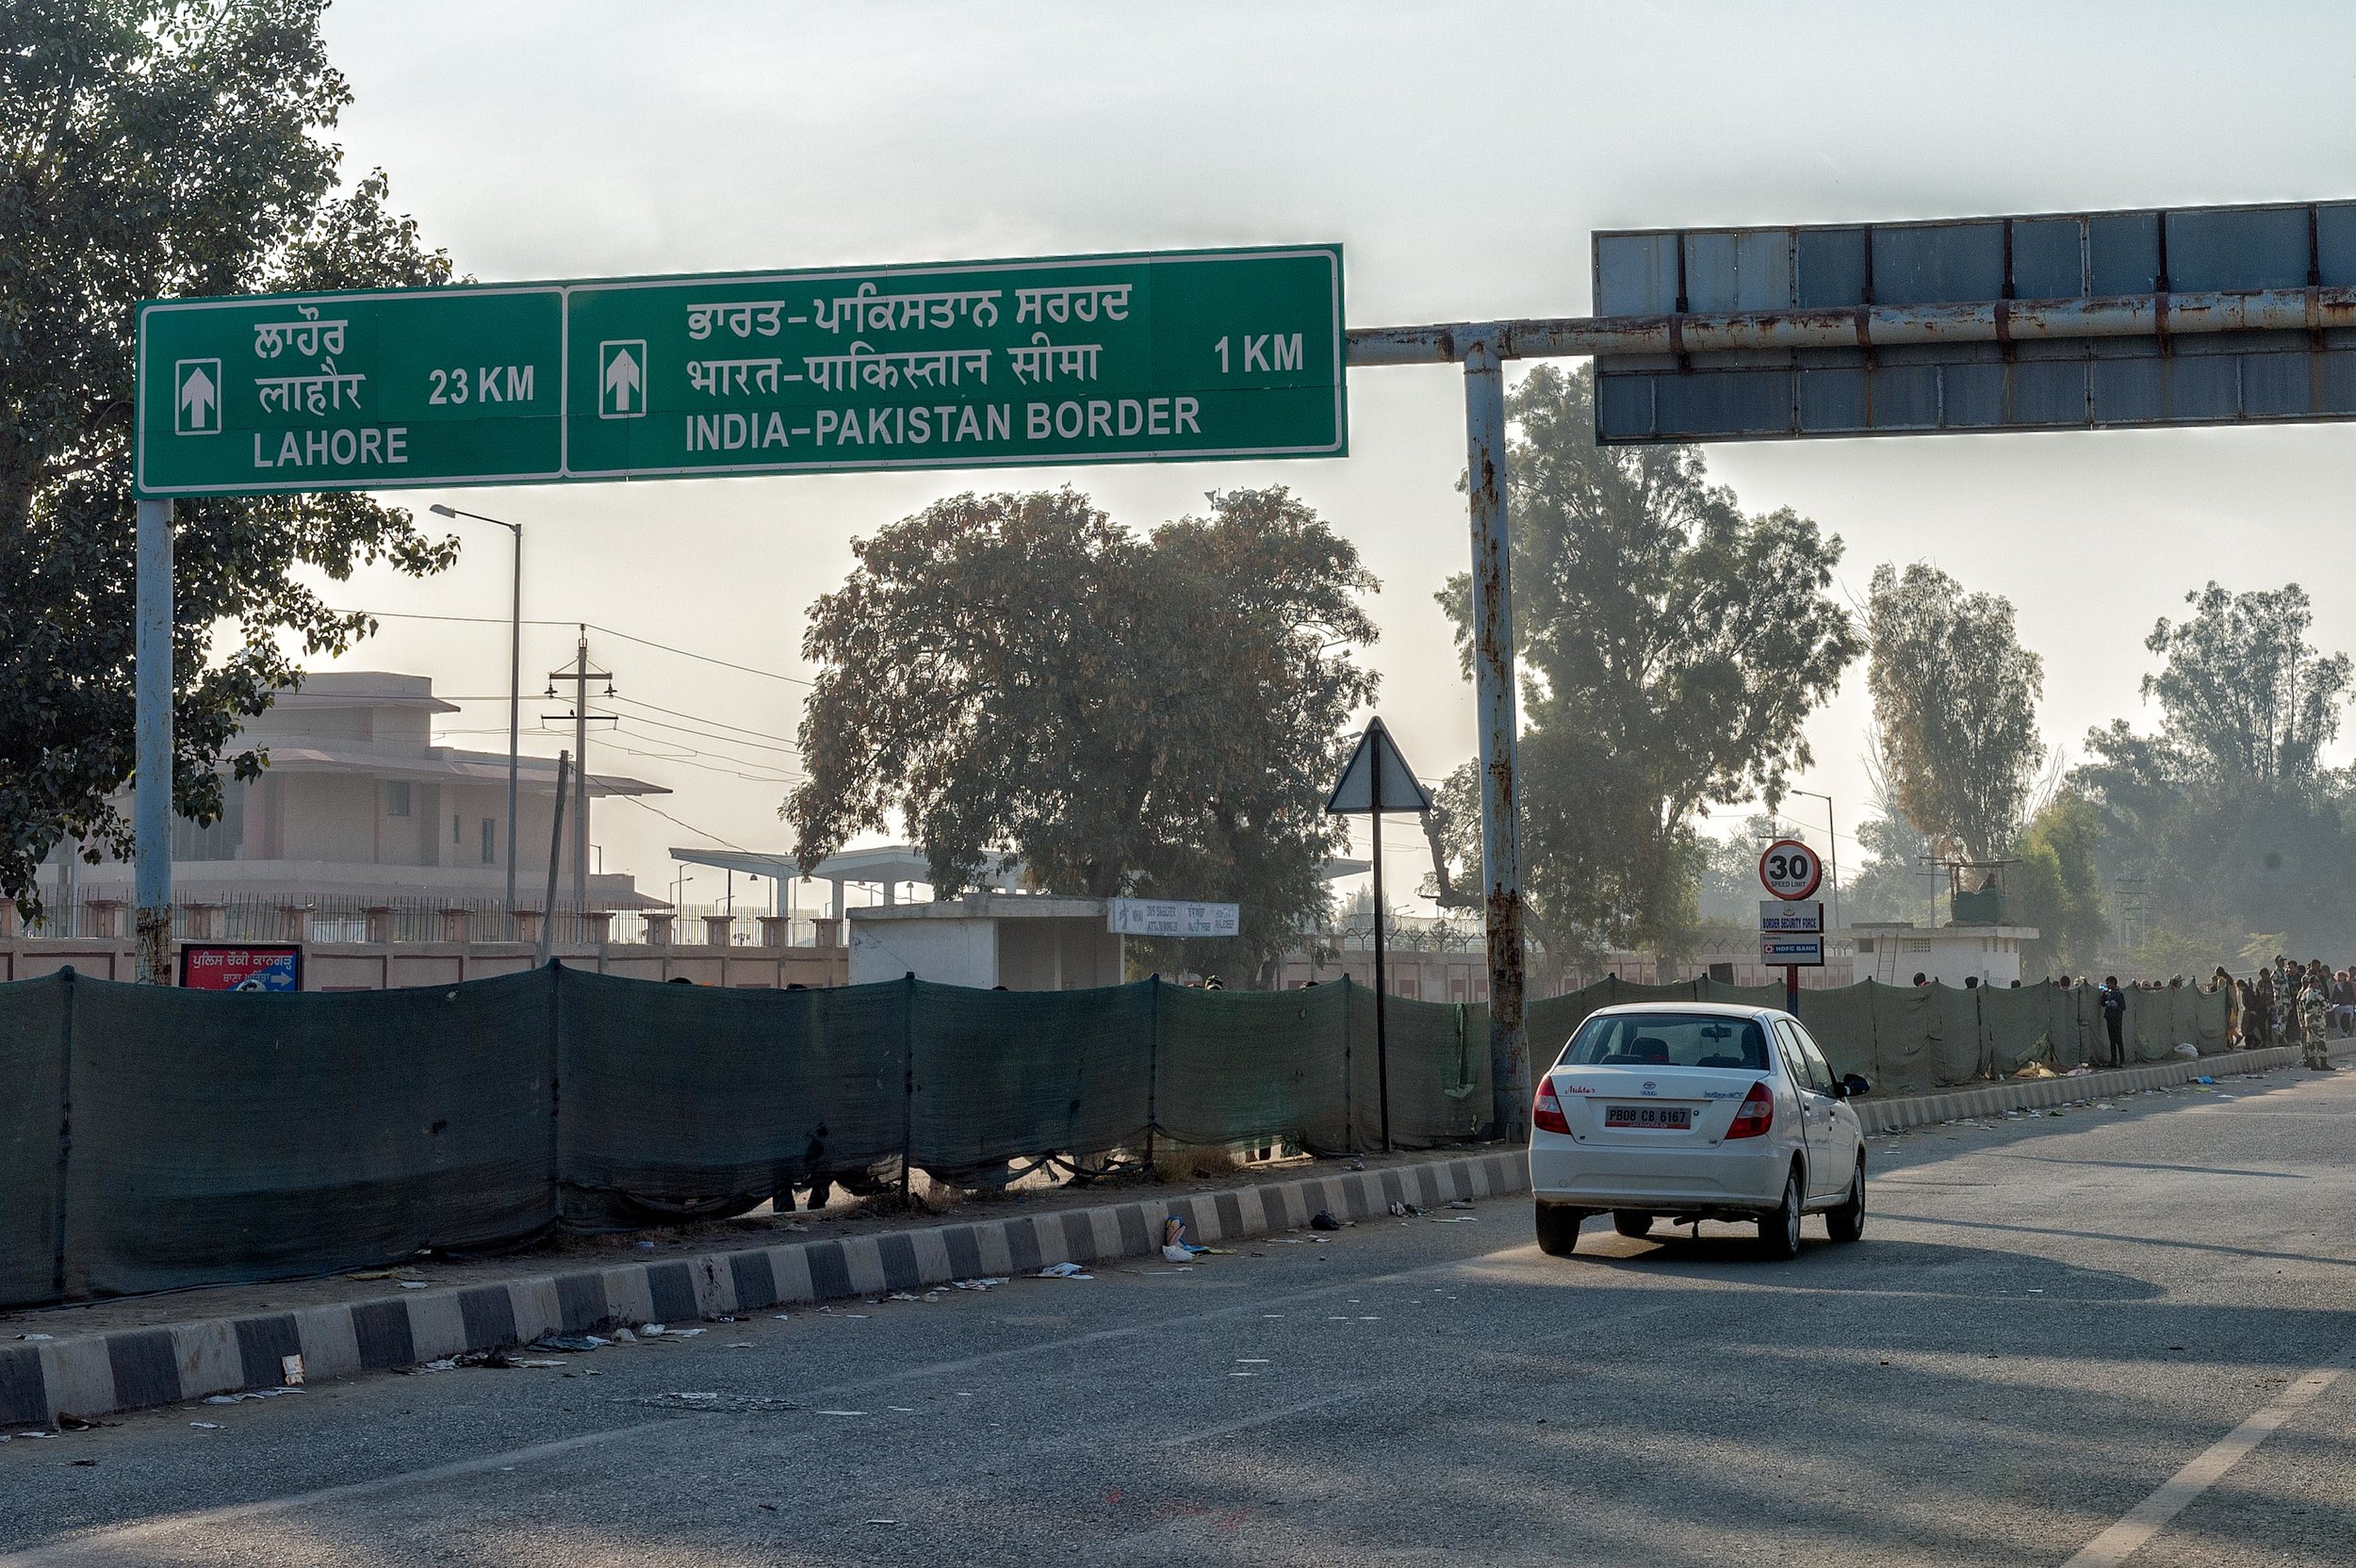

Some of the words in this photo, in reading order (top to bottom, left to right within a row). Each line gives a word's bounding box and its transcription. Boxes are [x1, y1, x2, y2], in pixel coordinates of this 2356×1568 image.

[686, 282, 1002, 340] ਭਾਰਤ-ਪਾਕਿਸਤਾਨ
[1015, 284, 1133, 324] ਸਰਹਦ
[254, 304, 349, 359] ਲਾਹੌਰ
[686, 340, 992, 397] भारत-पाकिस्तान
[1006, 331, 1104, 385] सीमा
[1214, 335, 1229, 373] 1
[1243, 333, 1303, 372] KM
[254, 355, 367, 416] लाहौर
[429, 368, 469, 405] 23
[478, 365, 535, 403] KM
[686, 402, 1010, 451] INDIA-PAKISTAN
[1026, 396, 1202, 439] BORDER
[254, 427, 408, 467] LAHORE
[1769, 855, 1808, 880] 30
[1762, 918, 1780, 929] BORDER
[1781, 918, 1802, 929] SECURITY
[1803, 918, 1817, 929] FORCE
[192, 951, 224, 969] ਪੁਲਿਸ
[226, 951, 251, 967] ਚੌਕੀ
[1610, 1109, 1637, 1121] PB08
[1641, 1110, 1656, 1122] CB
[1660, 1111, 1686, 1123] 6167
